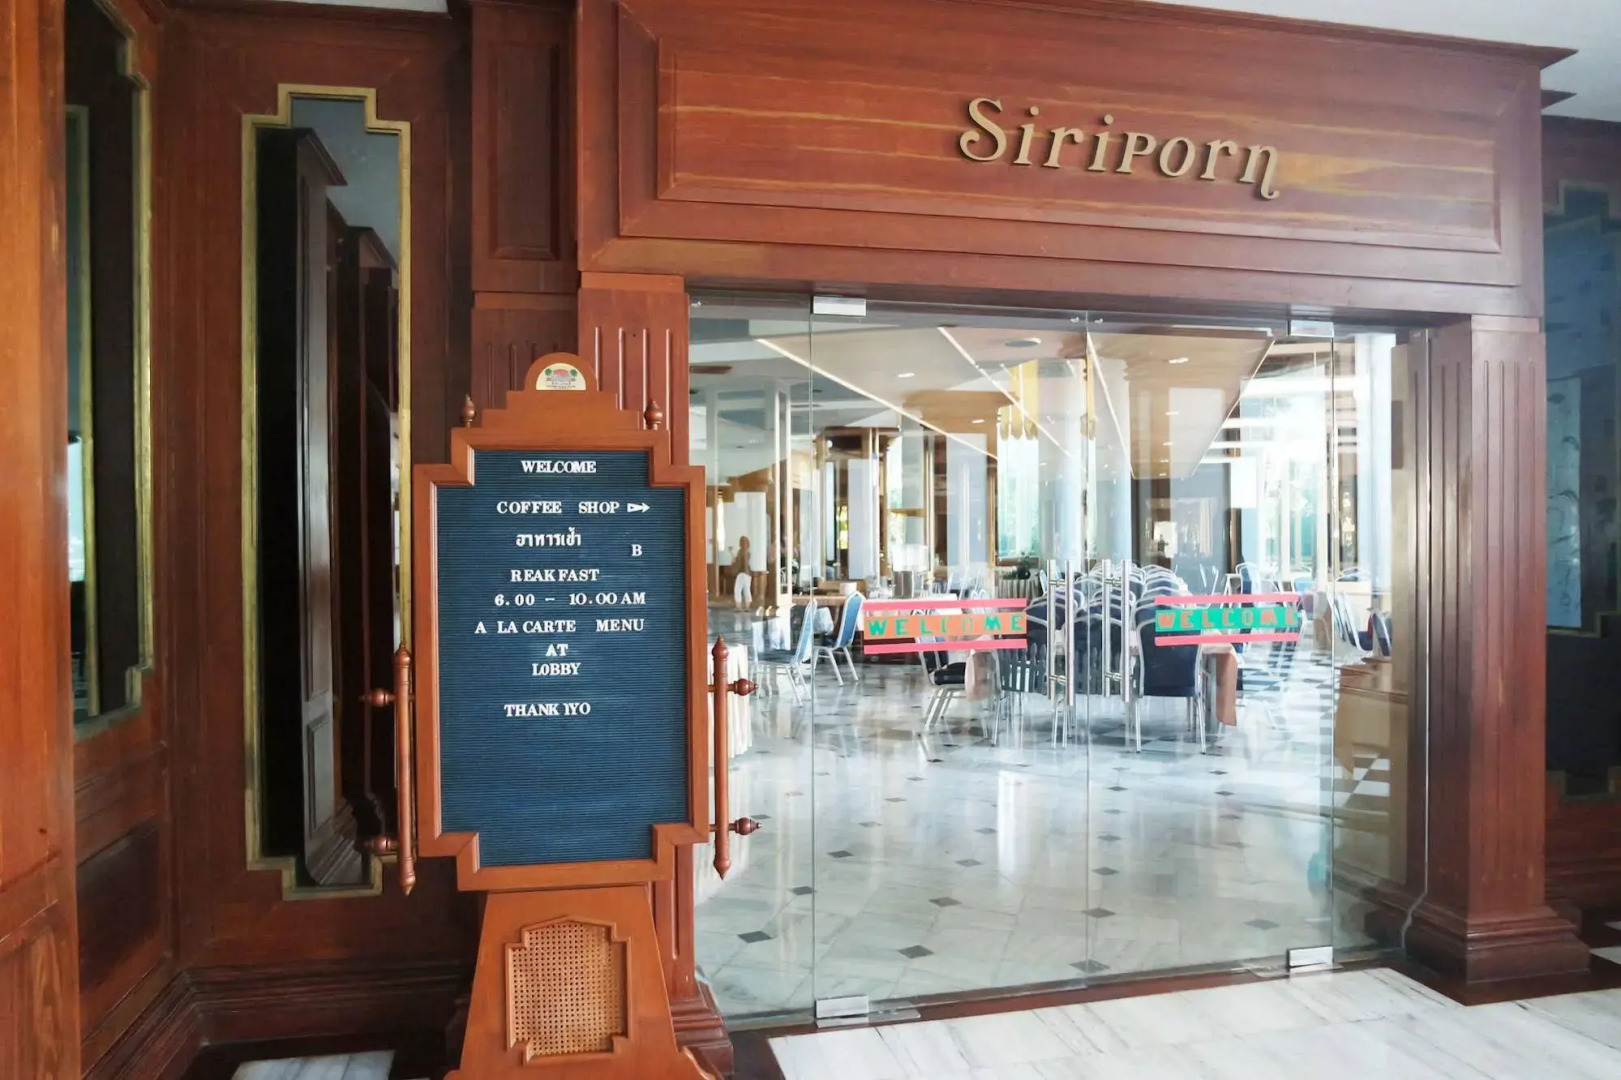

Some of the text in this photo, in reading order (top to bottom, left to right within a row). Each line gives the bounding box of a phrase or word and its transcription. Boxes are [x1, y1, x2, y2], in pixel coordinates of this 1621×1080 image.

[958, 97, 1281, 200] Siriporn
[520, 460, 597, 474] WELCOME
[496, 500, 620, 515] COFFEE SHOP
[631, 543, 643, 557] B
[494, 593, 536, 607] 6.00
[474, 618, 645, 634] A LA CARTE MENU
[868, 614, 1024, 637] WELCOME
[1157, 609, 1298, 629] WELCOME
[544, 643, 569, 657] AT
[531, 662, 582, 677] LOBBY
[503, 702, 560, 717] THANK
